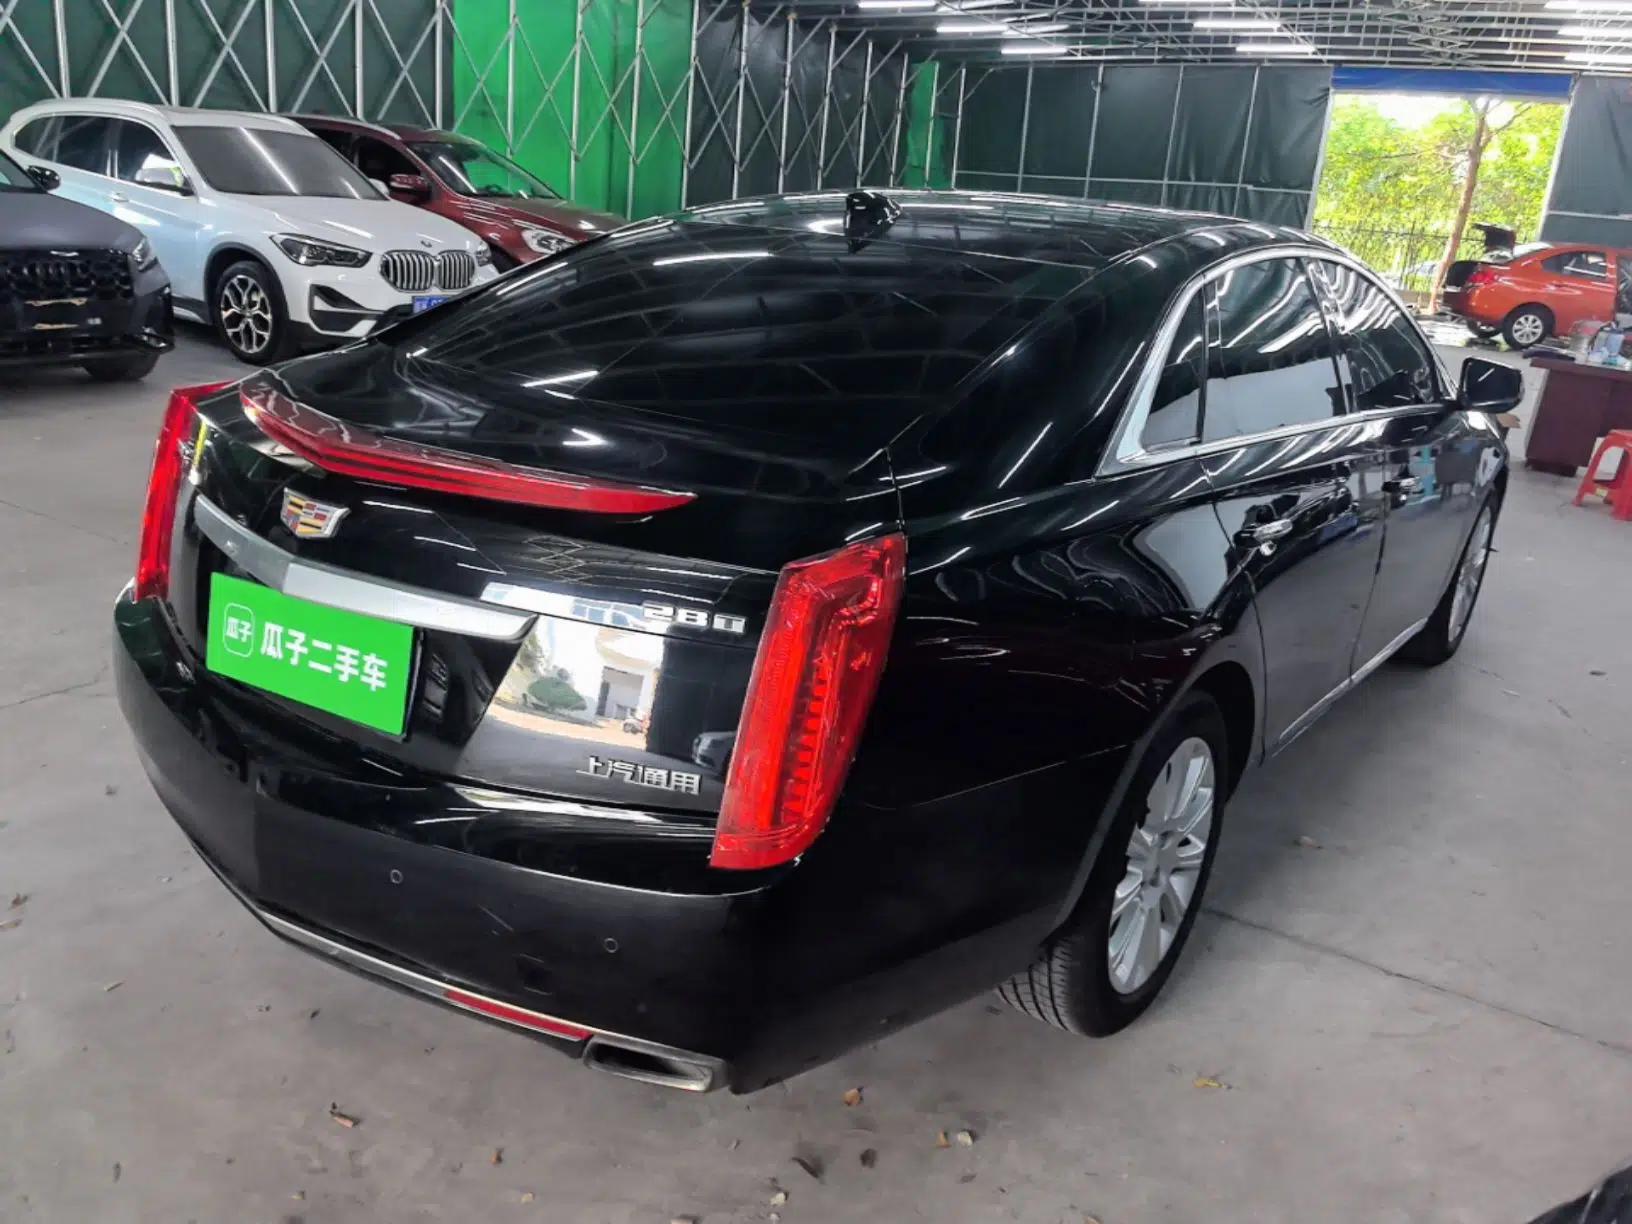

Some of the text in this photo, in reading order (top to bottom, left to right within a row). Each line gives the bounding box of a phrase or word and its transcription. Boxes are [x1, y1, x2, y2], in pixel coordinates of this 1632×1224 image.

[643, 602, 747, 633] 28T
[577, 756, 702, 795] 上汽通用
